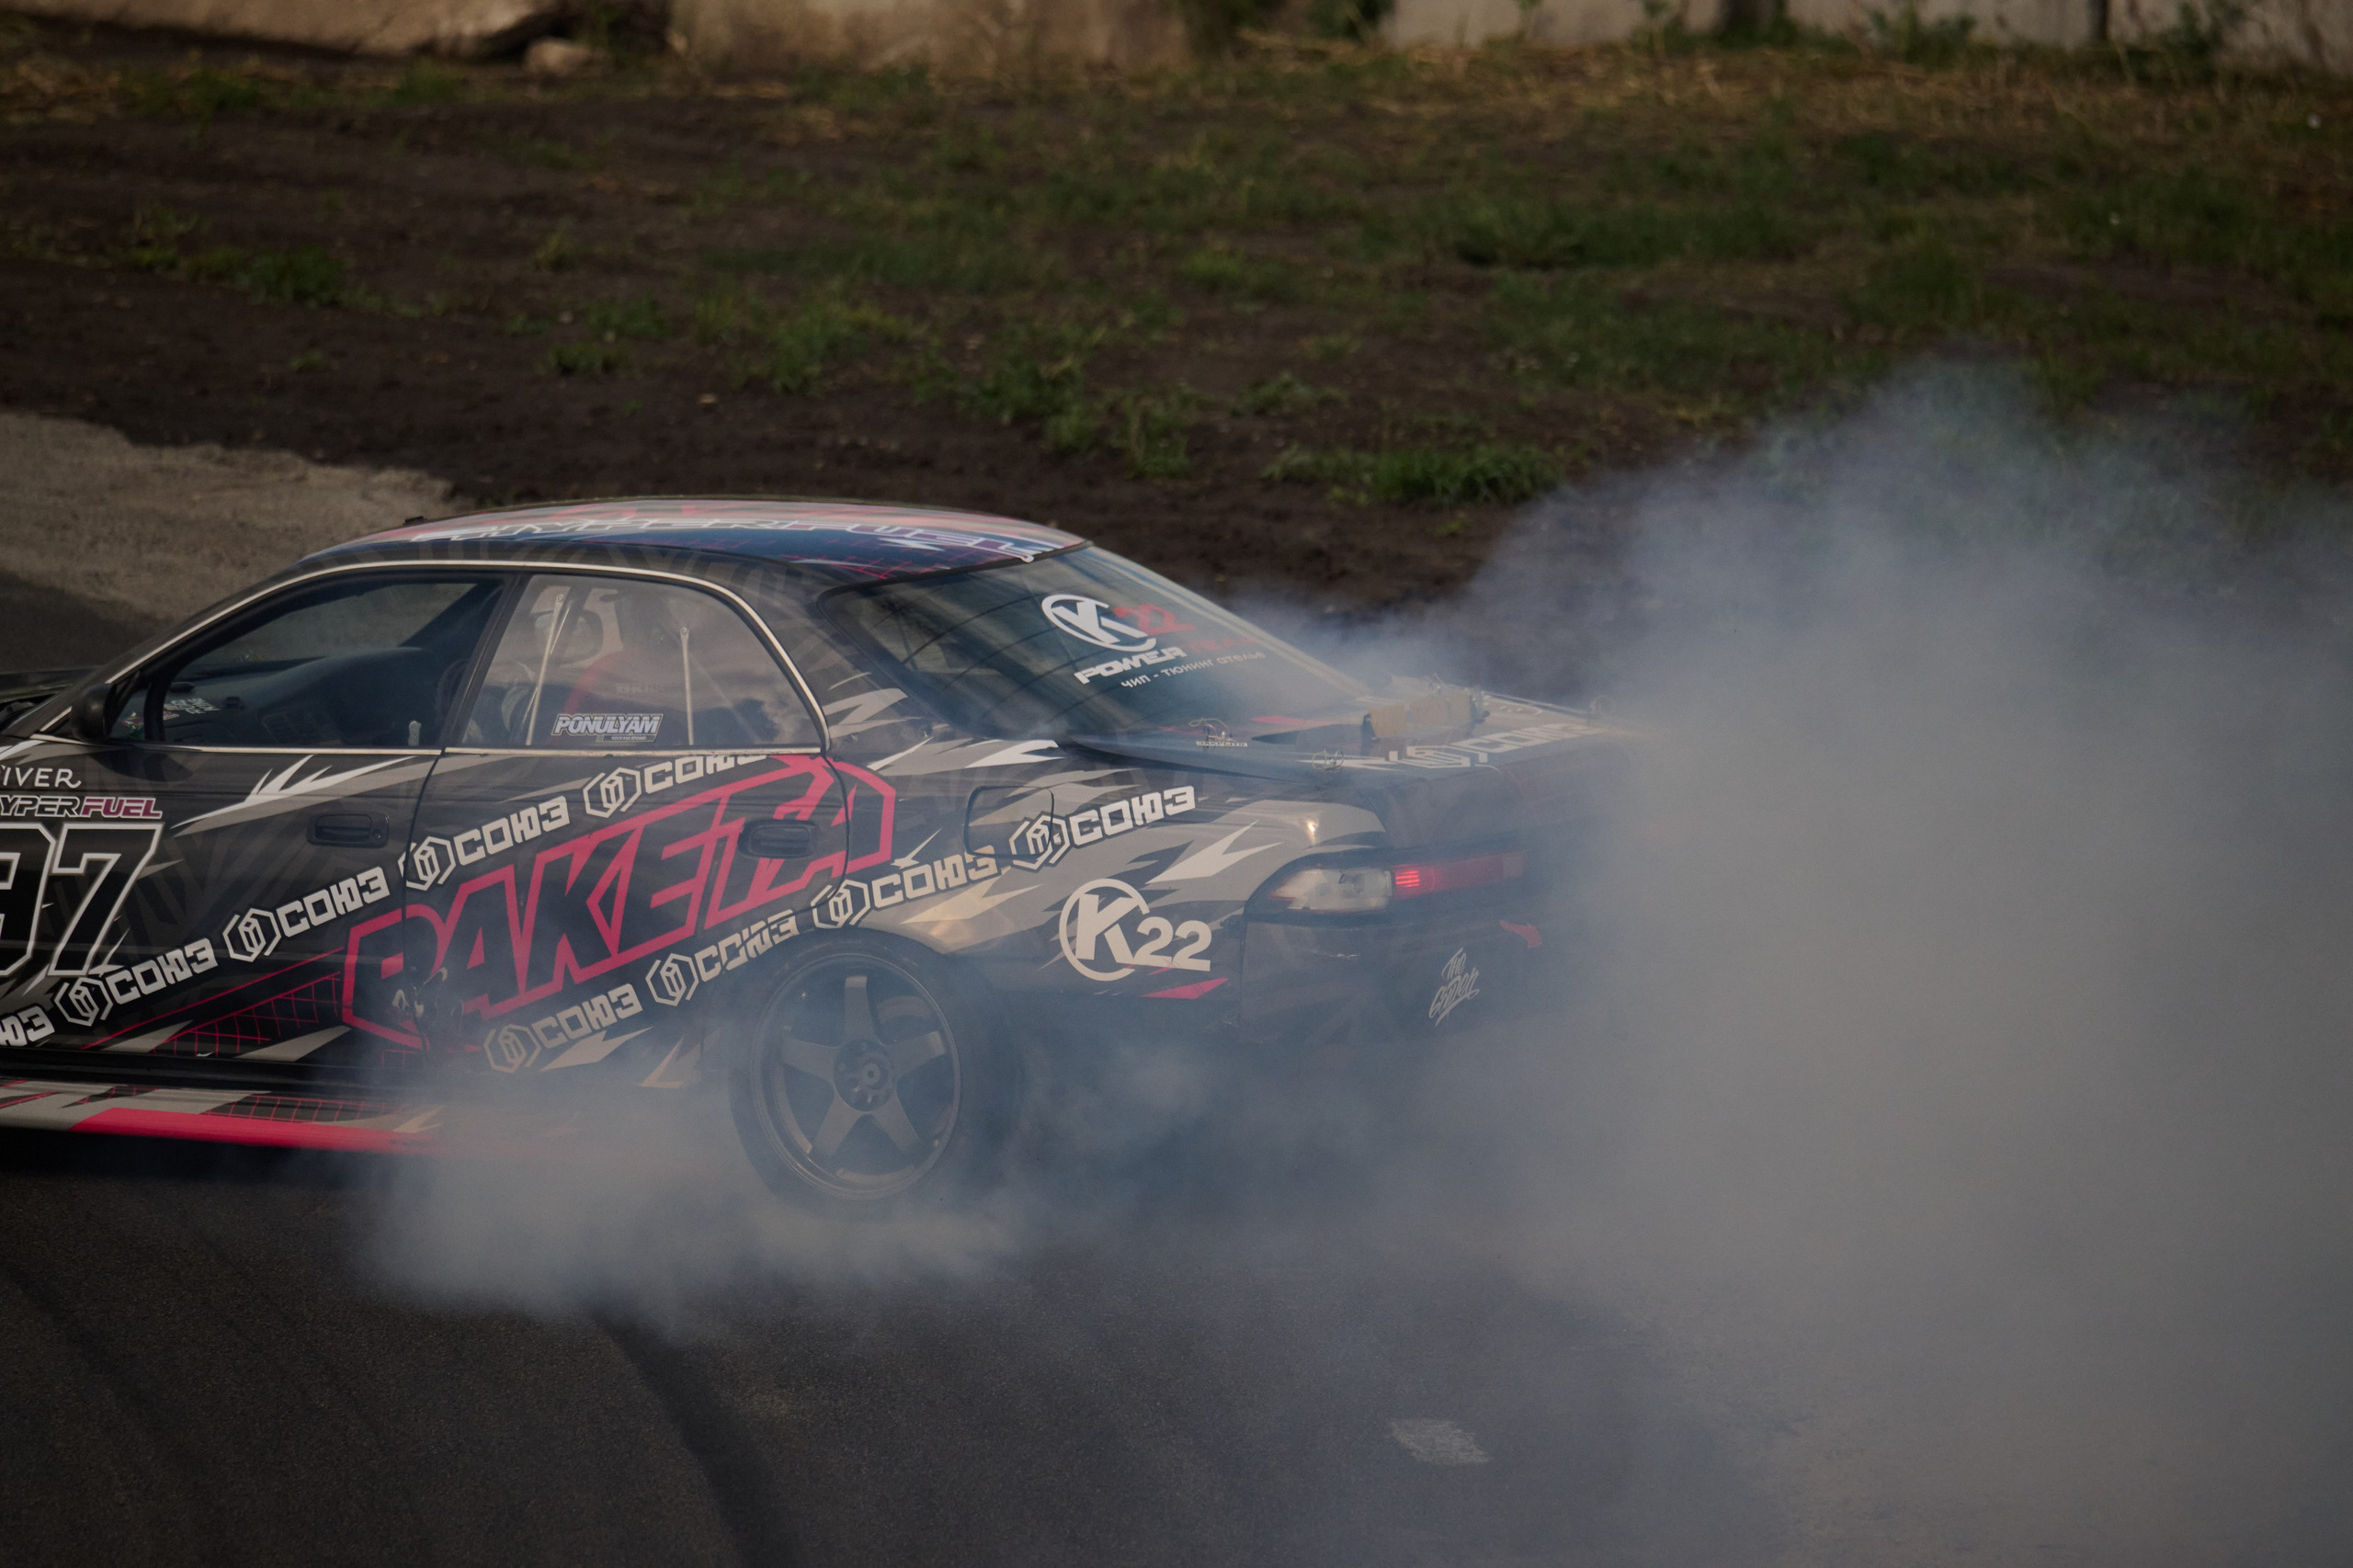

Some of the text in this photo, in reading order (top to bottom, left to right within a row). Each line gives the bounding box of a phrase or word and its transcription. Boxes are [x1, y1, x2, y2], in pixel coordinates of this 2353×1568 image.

[1074, 646, 1188, 685] POWER
[552, 715, 662, 735] PONULYAM
[1, 765, 82, 789] IVER
[453, 795, 571, 866] СОЮЗ
[1068, 785, 1196, 846] СОЮЗ
[275, 866, 390, 937] СОЮЗ
[871, 845, 998, 909] СОЮЗ
[1063, 882, 1211, 976] K22
[108, 937, 219, 1005] СОЮЗ
[531, 983, 643, 1049] СОЮЗ
